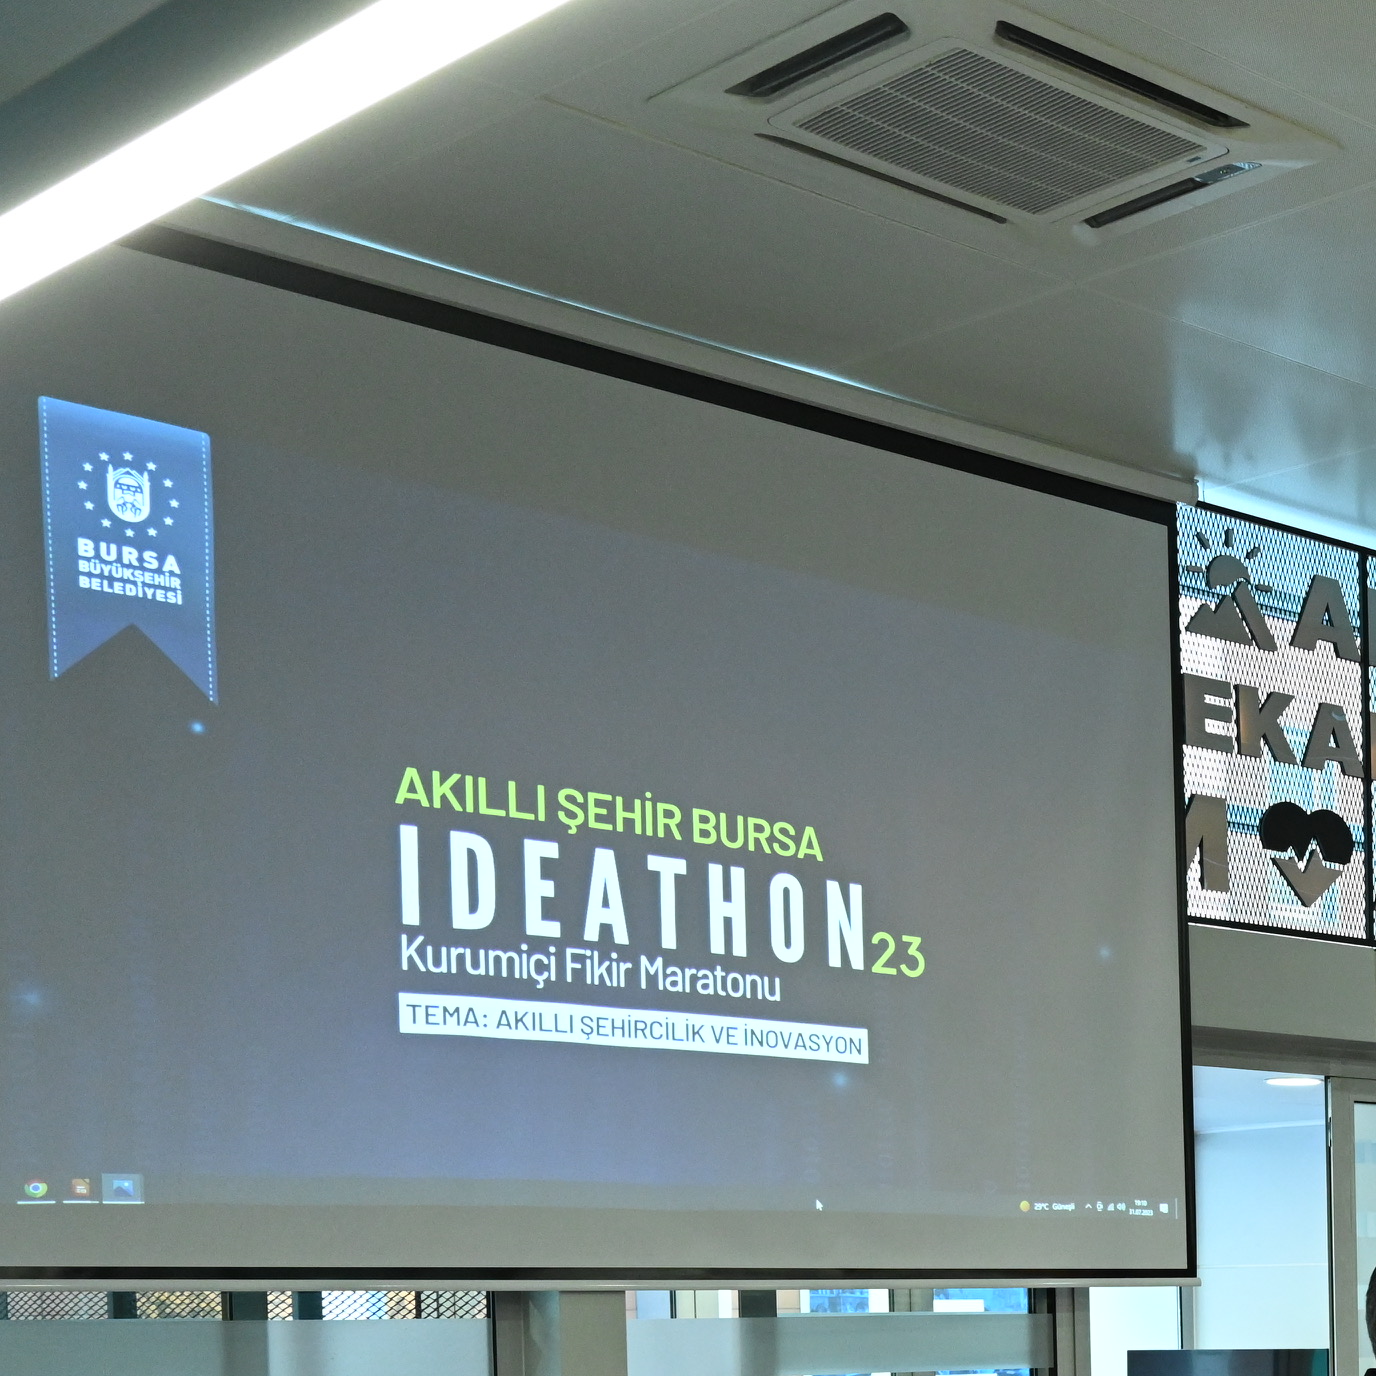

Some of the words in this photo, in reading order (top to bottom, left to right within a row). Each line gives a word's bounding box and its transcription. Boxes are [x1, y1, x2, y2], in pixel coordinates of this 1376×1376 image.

[77, 537, 181, 574] BURSA
[79, 559, 181, 590] BÜYÜKŞEHİR
[79, 575, 182, 605] BELEDİYESİ
[395, 767, 545, 822] AKILLI
[557, 788, 682, 840] ŞEHİR
[692, 808, 823, 861] BURSA
[399, 824, 864, 970] IDEATHON
[871, 932, 925, 977] 23
[401, 934, 556, 989] Kurumiçi
[566, 948, 632, 988] Fikir
[640, 955, 781, 1001] Maratonu
[406, 1004, 488, 1028] TEMA:
[496, 1009, 573, 1033] AKILLI
[580, 1014, 705, 1042] ŞEHİRCİLİK
[711, 1025, 738, 1046] VE
[744, 1023, 862, 1055] İNOVASYON
